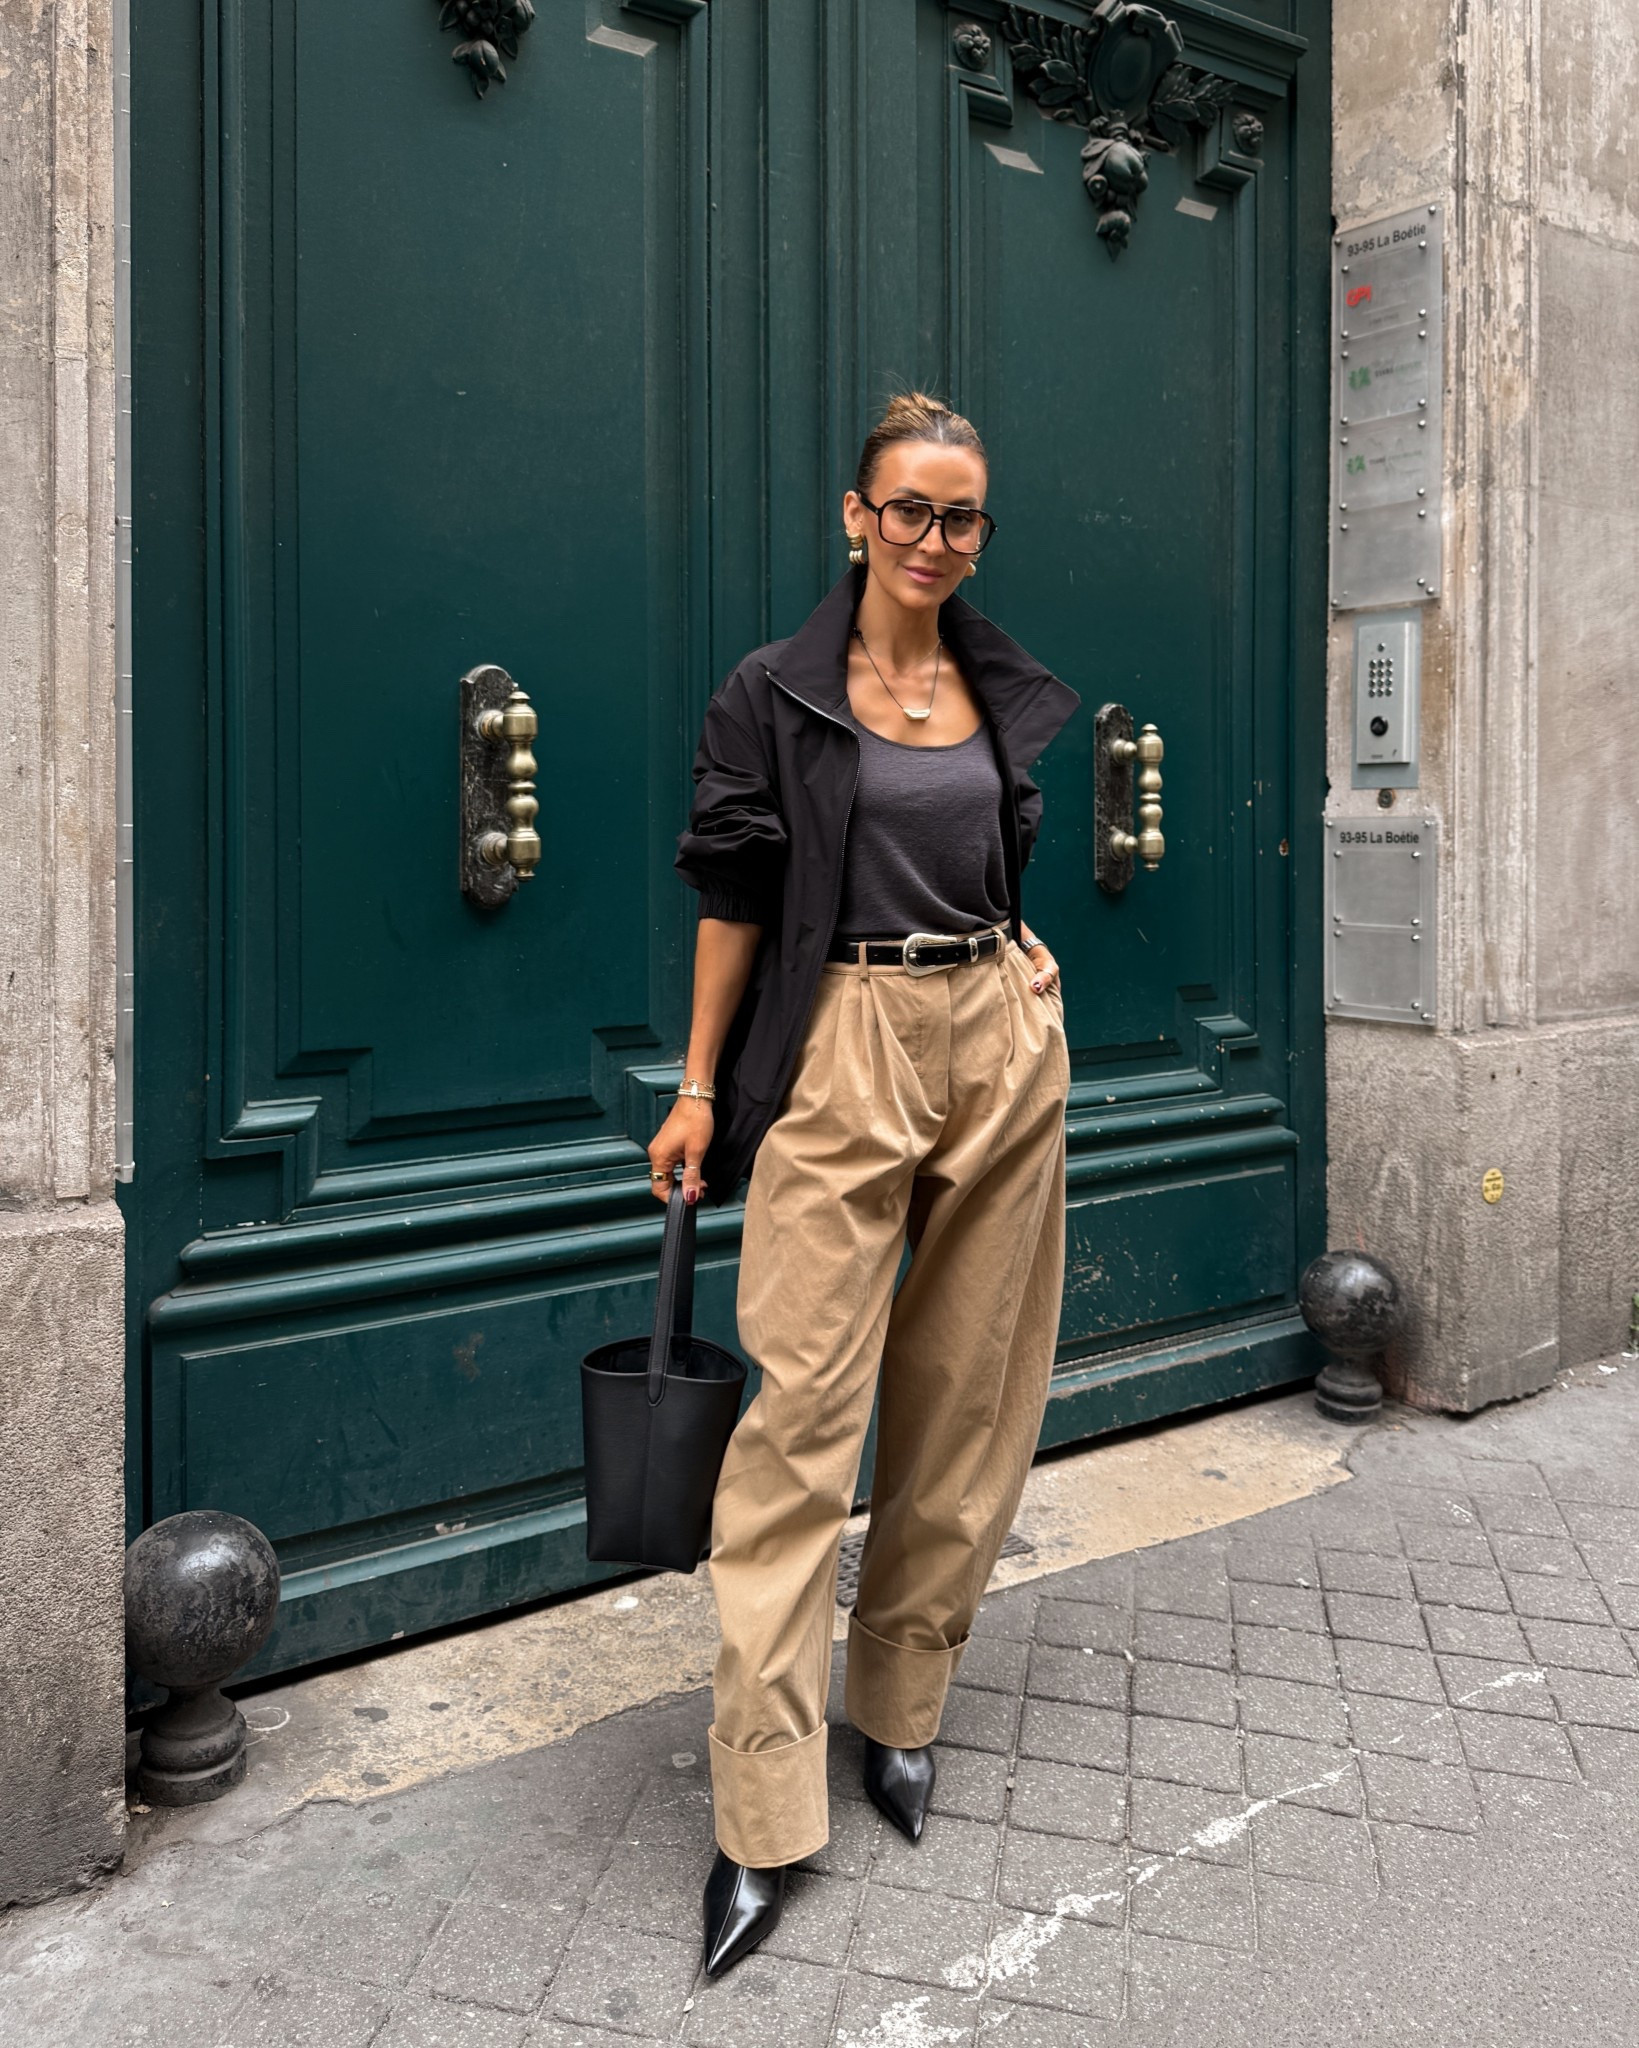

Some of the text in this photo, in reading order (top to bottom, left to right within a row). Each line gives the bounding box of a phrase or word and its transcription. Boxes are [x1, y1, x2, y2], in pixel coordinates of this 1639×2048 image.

[1347, 223, 1426, 257] 93-95 La Boétie
[1340, 830, 1419, 843] 93-95 La Boétie
